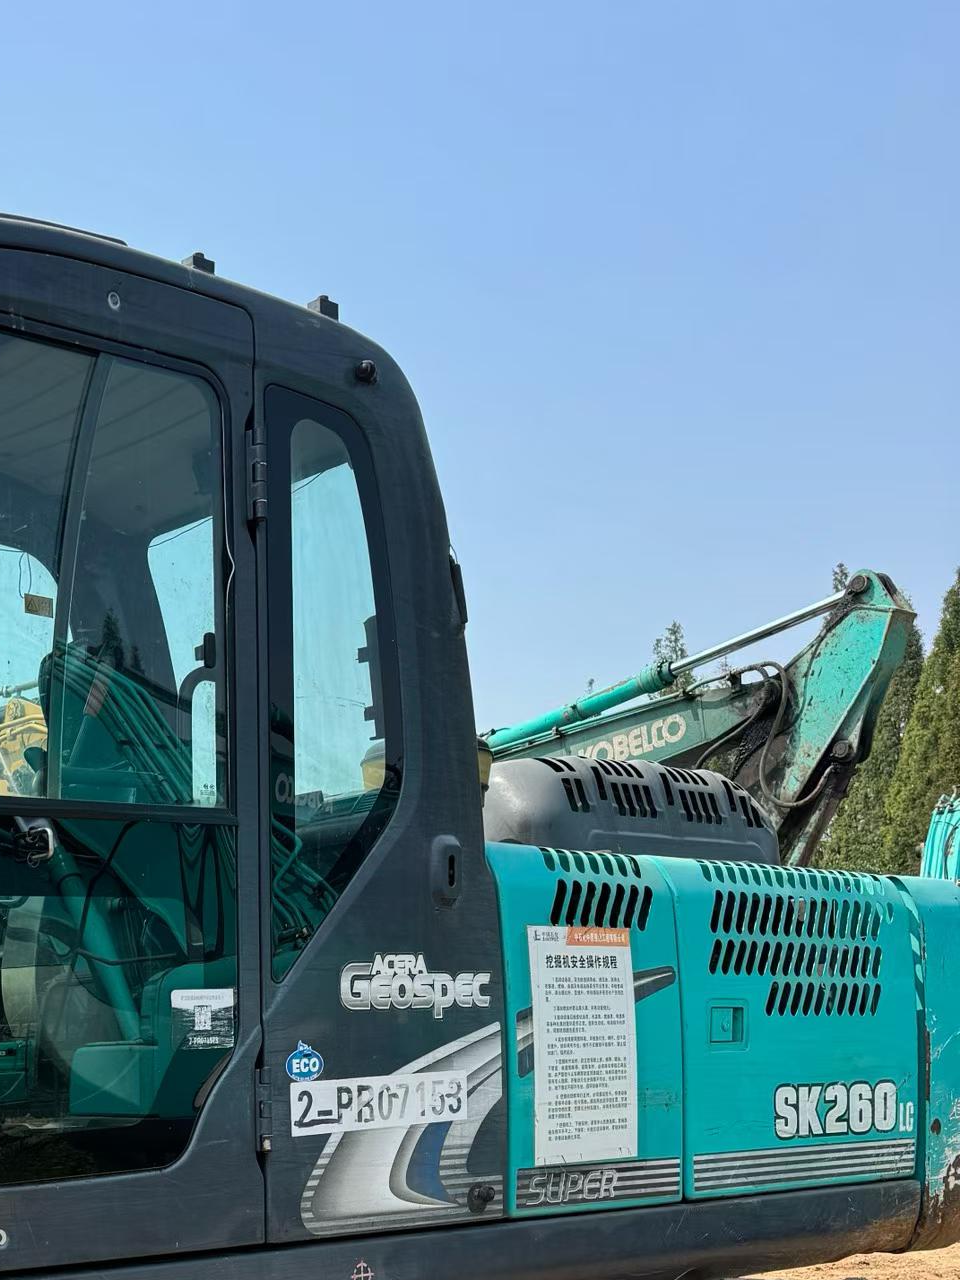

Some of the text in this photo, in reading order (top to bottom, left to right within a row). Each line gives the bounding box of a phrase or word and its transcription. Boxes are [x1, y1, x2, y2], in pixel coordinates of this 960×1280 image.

[371, 953, 430, 976] ACERA
[545, 954, 618, 969] 挖掘机安全操作规程
[292, 1057, 320, 1073] ECO
[774, 1080, 915, 1140] SK260 LC
[526, 1170, 618, 1205] SUPER
